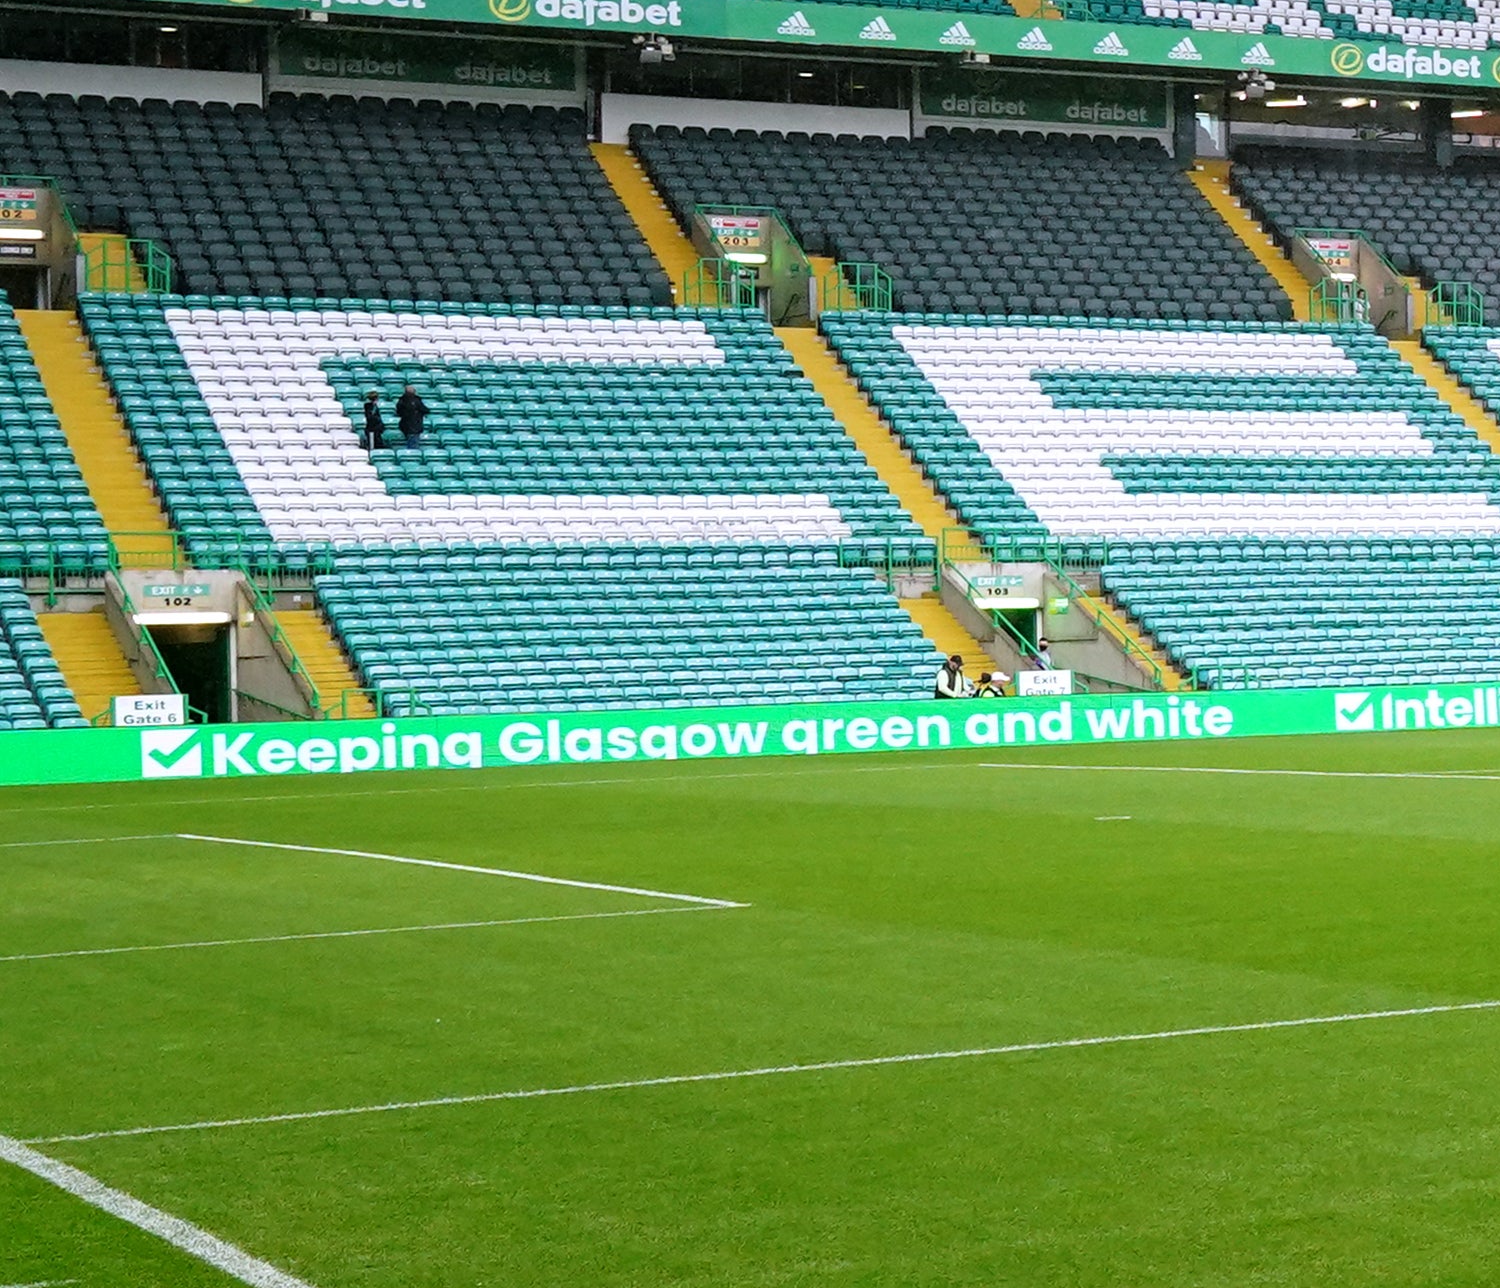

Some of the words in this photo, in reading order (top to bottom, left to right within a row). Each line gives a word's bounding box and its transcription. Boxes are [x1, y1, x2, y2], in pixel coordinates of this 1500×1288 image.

[1367, 46, 1482, 79] dafabet
[723, 237, 749, 246] 203
[151, 586, 176, 596] EXIT
[988, 587, 1009, 596] 103
[164, 597, 192, 607] 102
[1033, 675, 1057, 685] Exit
[134, 699, 166, 711] Exit
[123, 713, 162, 725] Gate
[168, 713, 177, 723] 6
[213, 722, 482, 775] Keeping
[498, 712, 770, 763] Glasgow
[782, 715, 951, 755] green
[965, 701, 1073, 745] and
[1075, 695, 1235, 741] white
